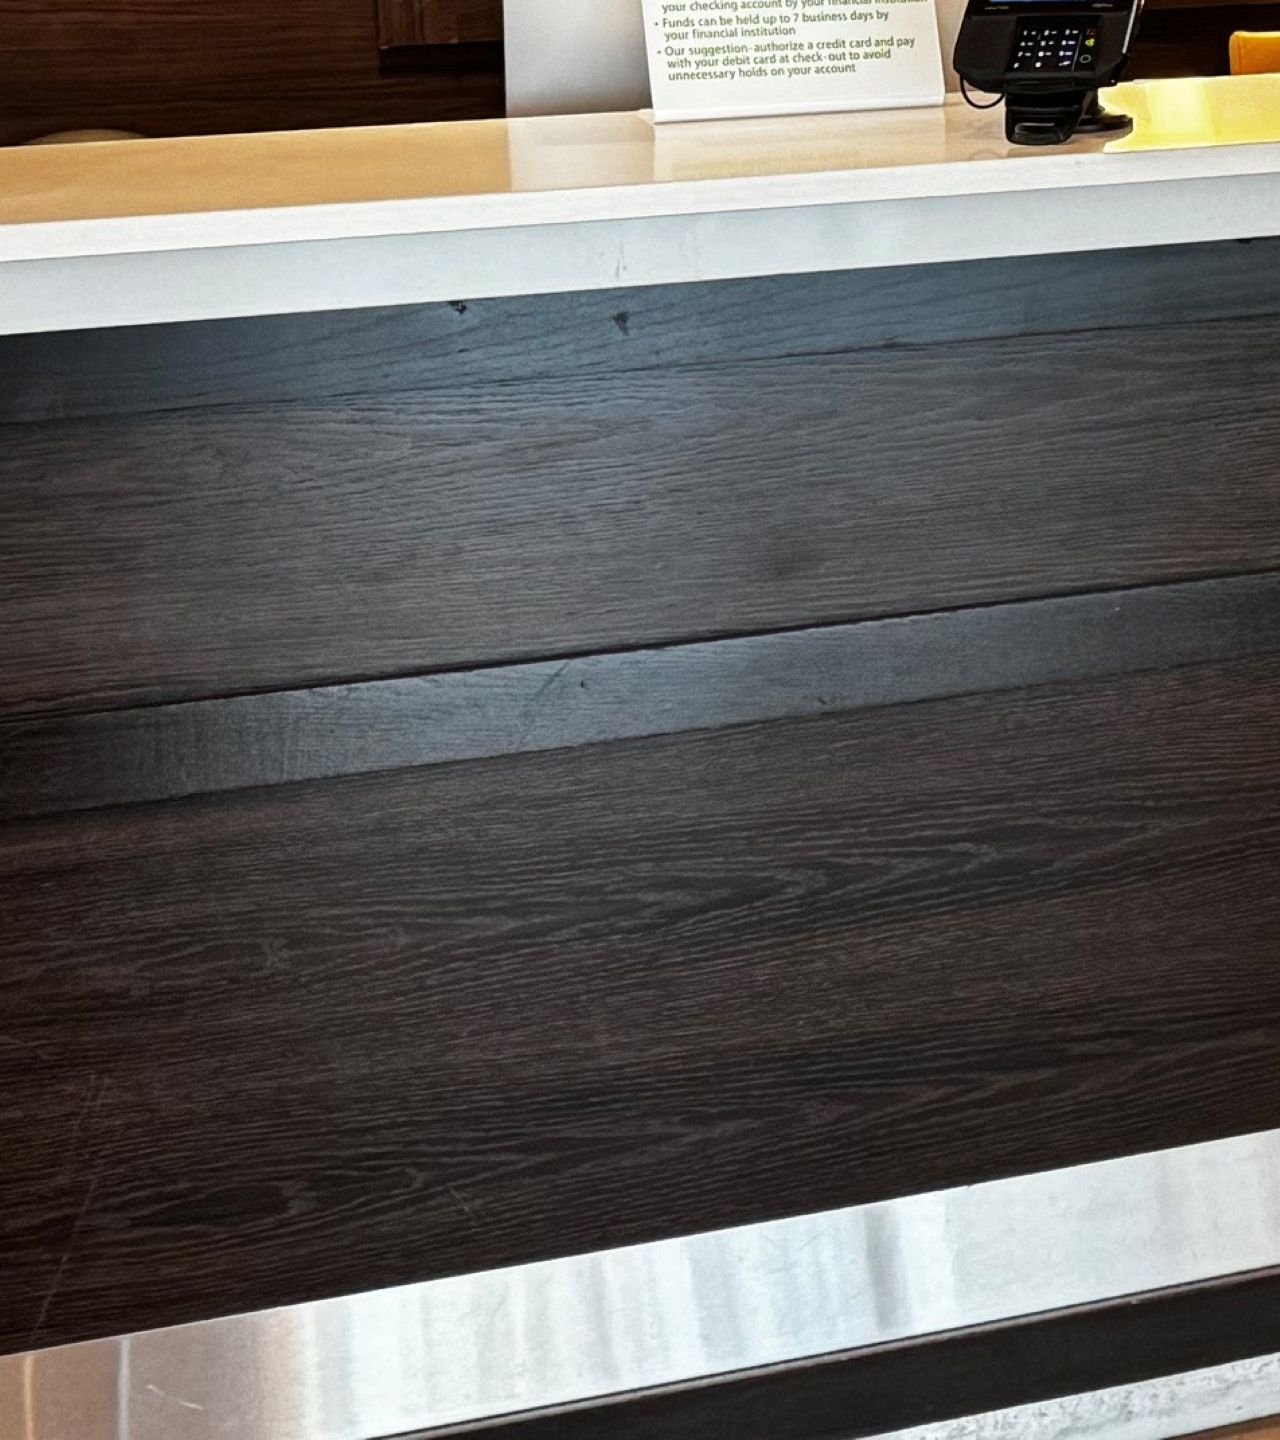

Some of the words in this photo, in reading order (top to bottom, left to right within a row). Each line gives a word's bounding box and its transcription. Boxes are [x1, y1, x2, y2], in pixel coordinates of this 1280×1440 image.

[662, 2, 686, 14] your
[690, 0, 738, 11] checking
[740, 0, 782, 9] account
[662, 17, 695, 28] Funds
[698, 18, 717, 26] can
[719, 16, 733, 26] be
[736, 14, 760, 25] held
[762, 15, 777, 26] up
[780, 14, 791, 23] to
[793, 13, 799, 22] 7
[802, 12, 847, 23] business
[850, 10, 874, 22] days
[876, 10, 889, 22] by
[664, 31, 689, 42] your
[692, 28, 738, 39] financial
[741, 26, 796, 37] institution
[664, 46, 685, 56] Our
[816, 39, 846, 49] credit
[850, 37, 872, 48] card
[874, 36, 895, 47] and
[896, 37, 915, 48] pay
[667, 58, 691, 68] with
[695, 58, 719, 69] your
[722, 56, 750, 66] debit
[753, 54, 776, 65] card
[779, 54, 790, 63] at
[849, 51, 860, 60] to
[863, 49, 891, 60] avoid
[668, 69, 736, 81] unnecessary
[738, 67, 768, 78] holds
[771, 68, 784, 76] on
[788, 66, 812, 78] your
[814, 64, 856, 75] account
